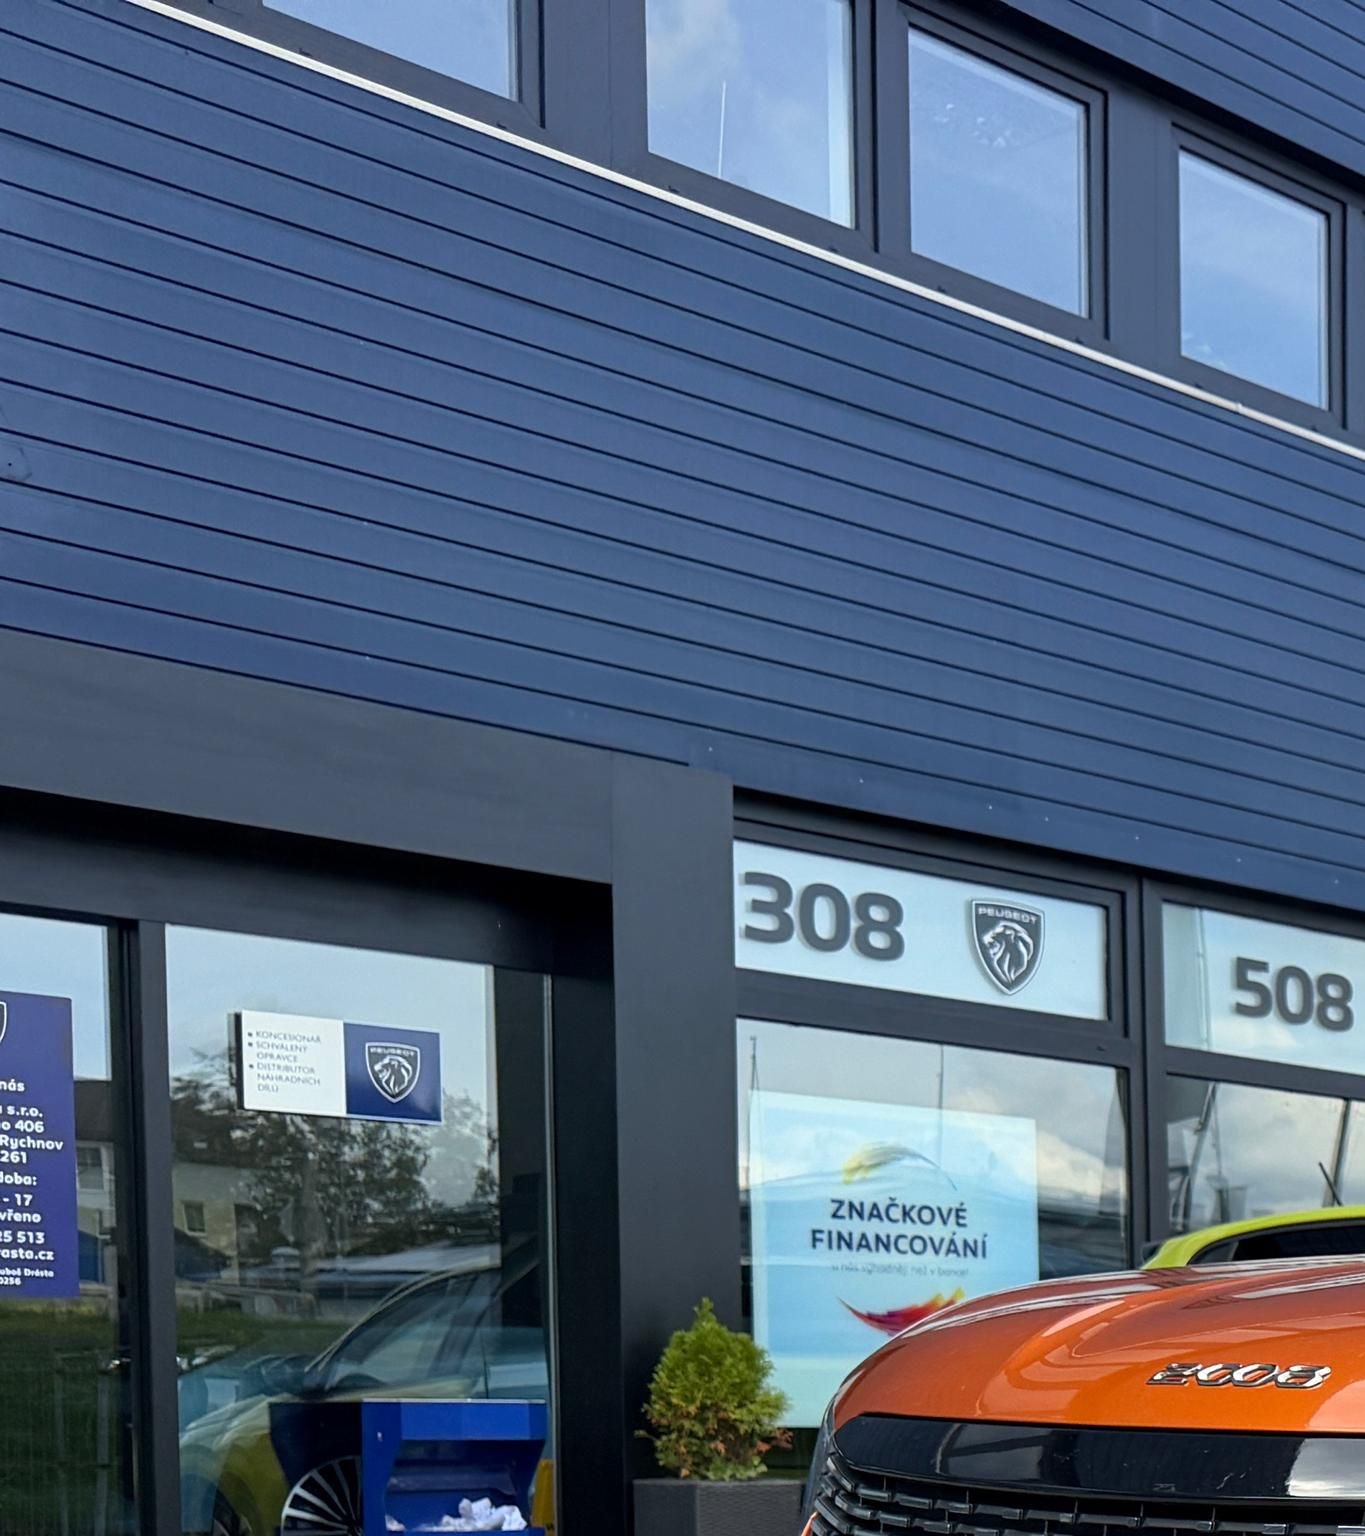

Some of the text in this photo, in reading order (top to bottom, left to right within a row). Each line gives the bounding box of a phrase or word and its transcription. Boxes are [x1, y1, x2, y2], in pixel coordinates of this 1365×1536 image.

[742, 871, 905, 961] 308
[978, 906, 1039, 925] PEUGEOT
[1235, 957, 1354, 1031] 508
[370, 1047, 415, 1057] PEUGEOT
[7, 1105, 43, 1117] s.r.o.
[15, 1120, 44, 1133] 406
[0, 1134, 63, 1150] Rychnov
[0, 1150, 27, 1164] 261
[15, 1193, 32, 1206] 17
[830, 1197, 968, 1228] ZNAČKOVÉ
[17, 1231, 45, 1244] 513
[811, 1229, 988, 1259] FINANCOVÁNÍ
[24, 1268, 54, 1278] Drásta
[1146, 1363, 1332, 1390] 2008
